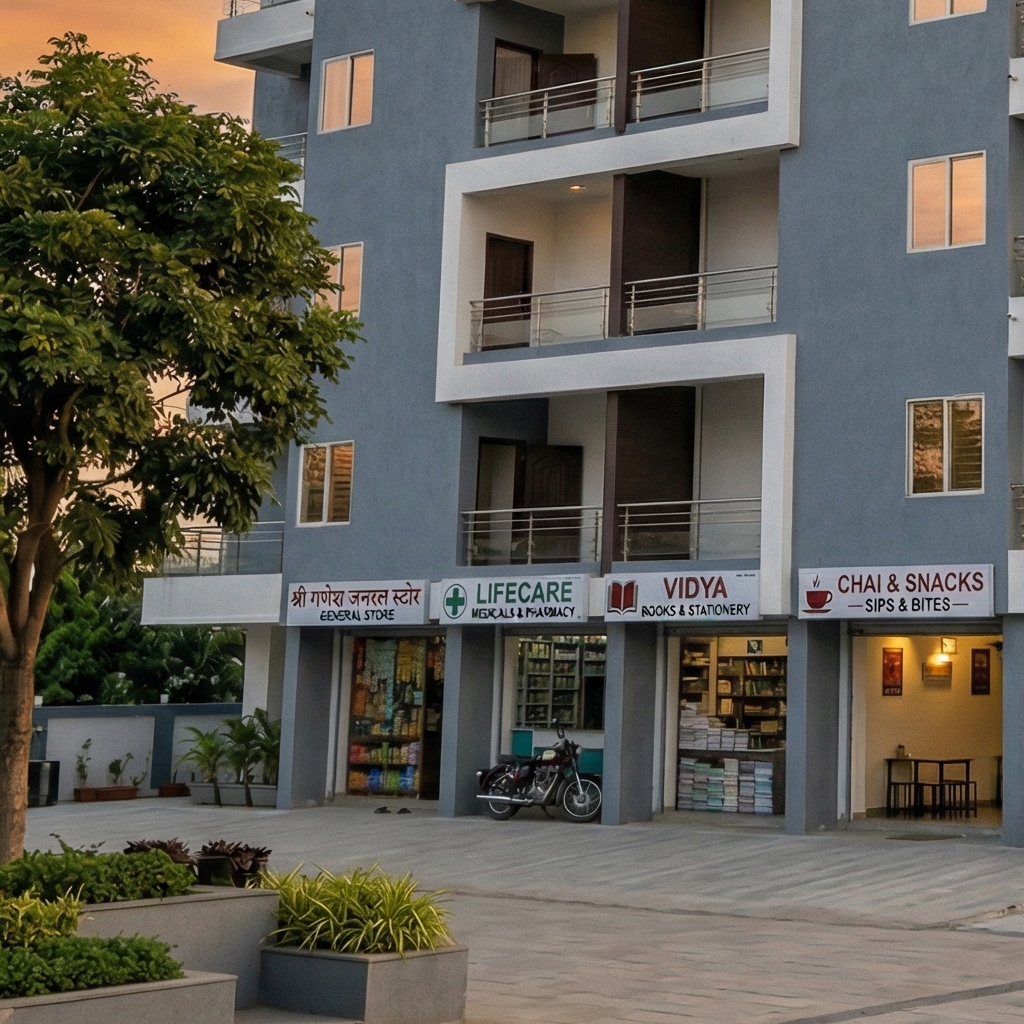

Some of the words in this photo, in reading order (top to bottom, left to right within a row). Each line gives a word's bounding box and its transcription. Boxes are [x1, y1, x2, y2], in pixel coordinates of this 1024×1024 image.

[476, 581, 573, 604] LIFECARE
[663, 576, 728, 599] VIDYA
[838, 574, 881, 594] CHAI
[887, 573, 900, 593] &
[905, 571, 984, 593] SNACKS
[290, 584, 307, 608] श्री
[348, 589, 389, 607] जनरल
[392, 582, 421, 606] स्टोर
[865, 597, 895, 613] SIPS
[898, 597, 908, 612] &
[911, 597, 951, 612] BITES
[364, 609, 395, 621] STORE
[678, 604, 686, 616] &
[688, 603, 751, 616] STATIONERY
